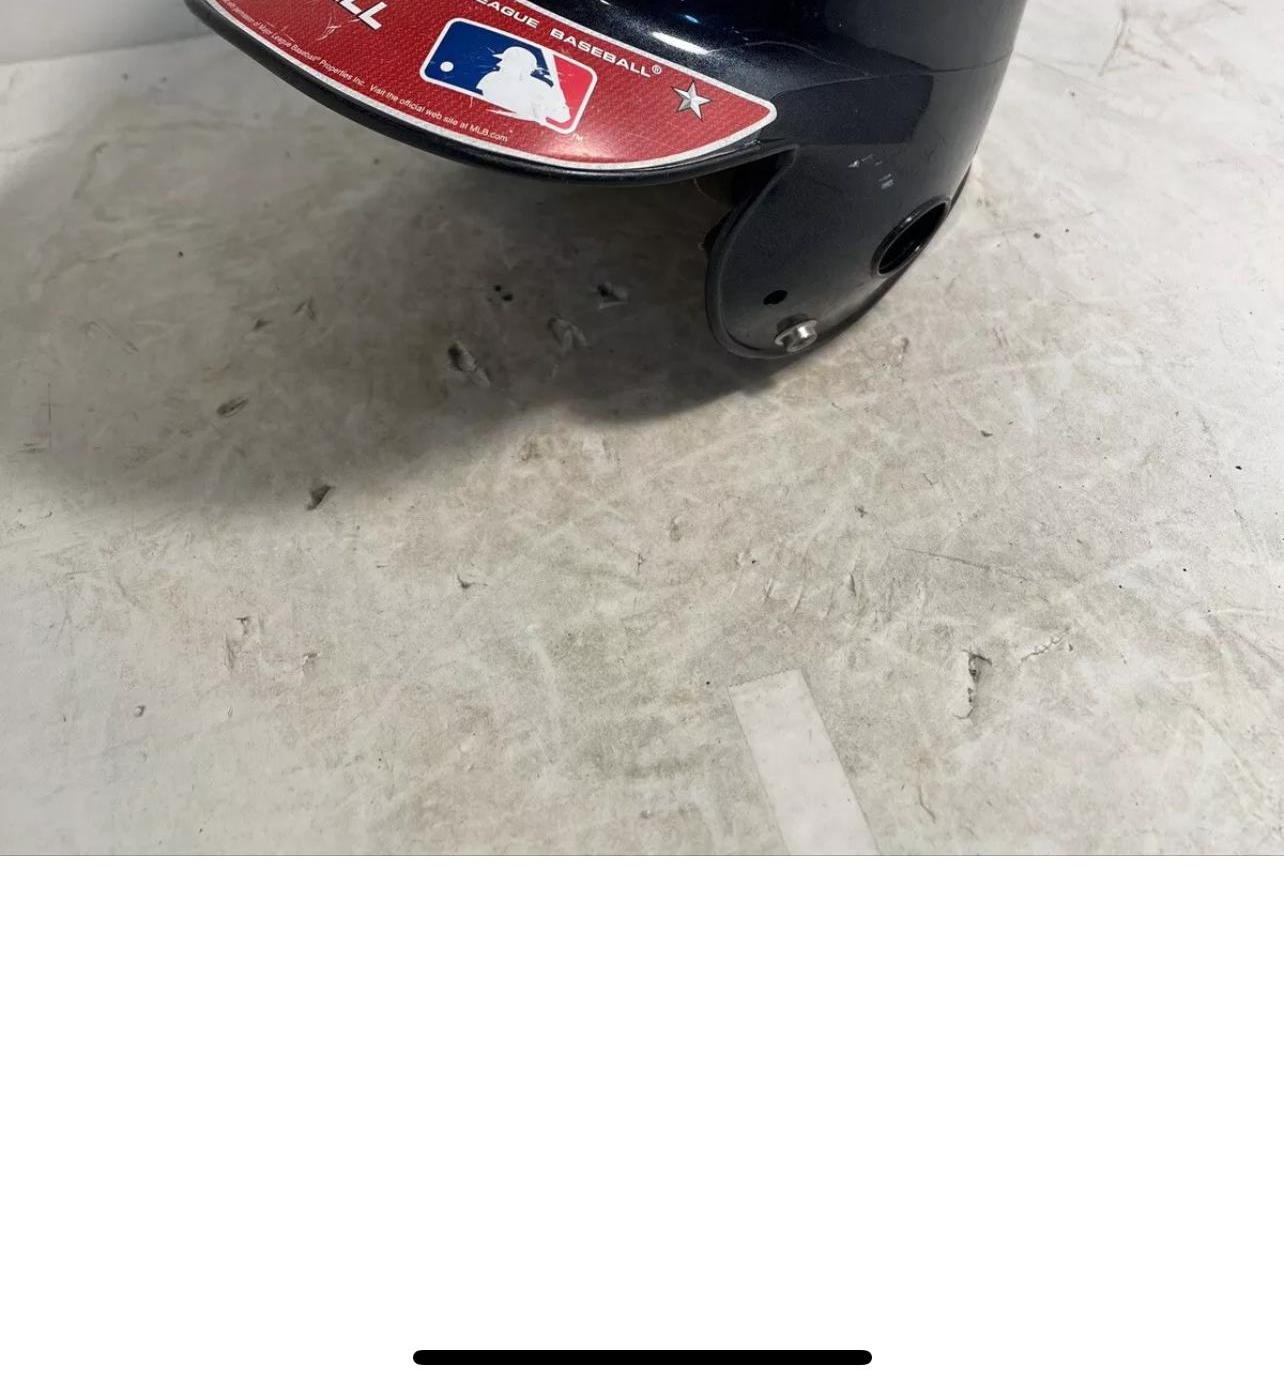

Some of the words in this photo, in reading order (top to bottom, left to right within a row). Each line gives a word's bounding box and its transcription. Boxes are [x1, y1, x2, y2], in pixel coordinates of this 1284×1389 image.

[271, 32, 292, 48] League
[319, 59, 353, 81] Properties
[370, 84, 386, 97] Visit
[386, 90, 399, 102] the
[399, 98, 426, 113] official
[425, 109, 442, 120] web
[443, 115, 458, 126] site
[459, 121, 468, 130] at
[469, 123, 509, 143] MLB.com
